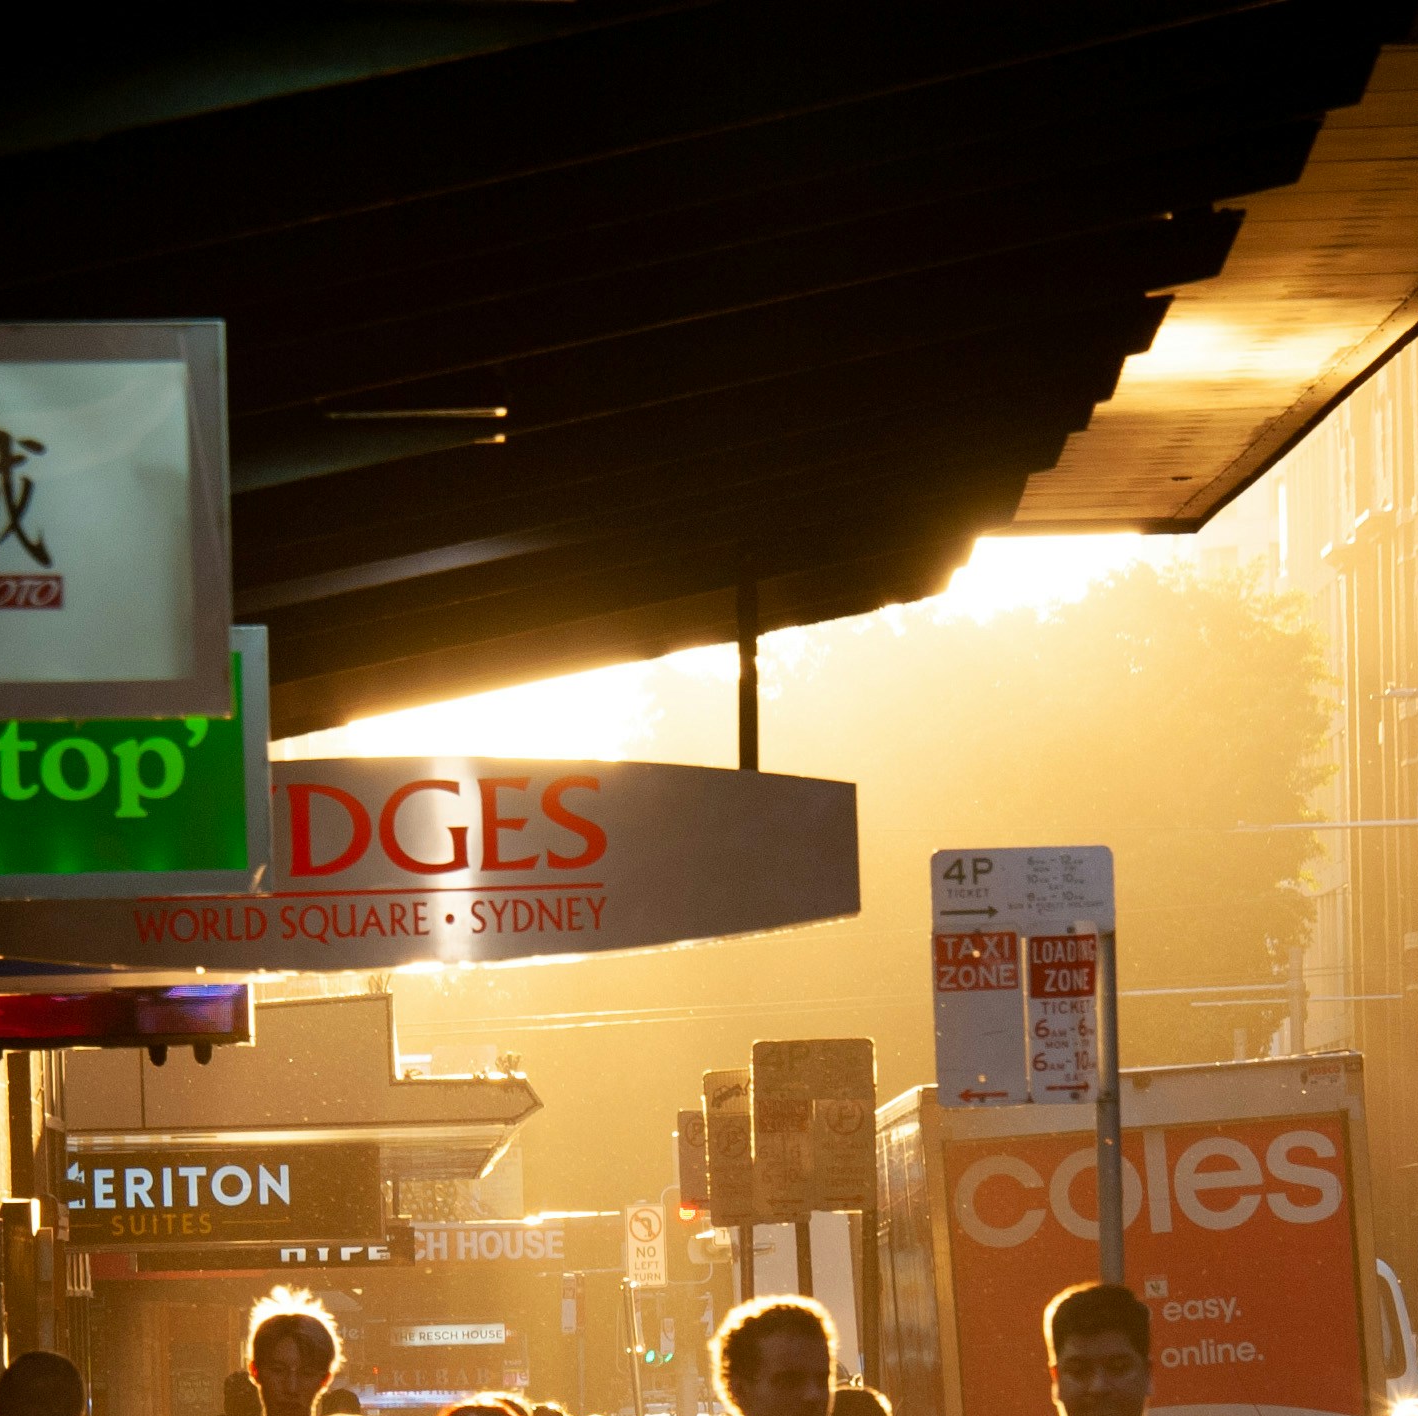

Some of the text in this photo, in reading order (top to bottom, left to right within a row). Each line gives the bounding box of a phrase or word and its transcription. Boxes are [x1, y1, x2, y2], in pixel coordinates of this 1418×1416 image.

[271, 776, 609, 879] DGES
[942, 857, 994, 886] 4P
[947, 888, 990, 899] TICKET
[135, 896, 609, 948] WORLD SQUARE SYDNEY
[942, 935, 1011, 960] TAXI
[939, 963, 1015, 988] ZONE
[1044, 968, 1091, 993] ZONE
[954, 1130, 1343, 1249] coles
[111, 1213, 213, 1236] SUITES
[457, 1230, 565, 1260] HOUSE
[636, 1246, 656, 1258] NO
[633, 1273, 661, 1281] TURN
[634, 1261, 659, 1270] LEFT
[1162, 1296, 1242, 1324] easy.
[419, 1331, 459, 1341] RESCH
[462, 1329, 503, 1340] HOUSE
[1159, 1338, 1265, 1369] online.
